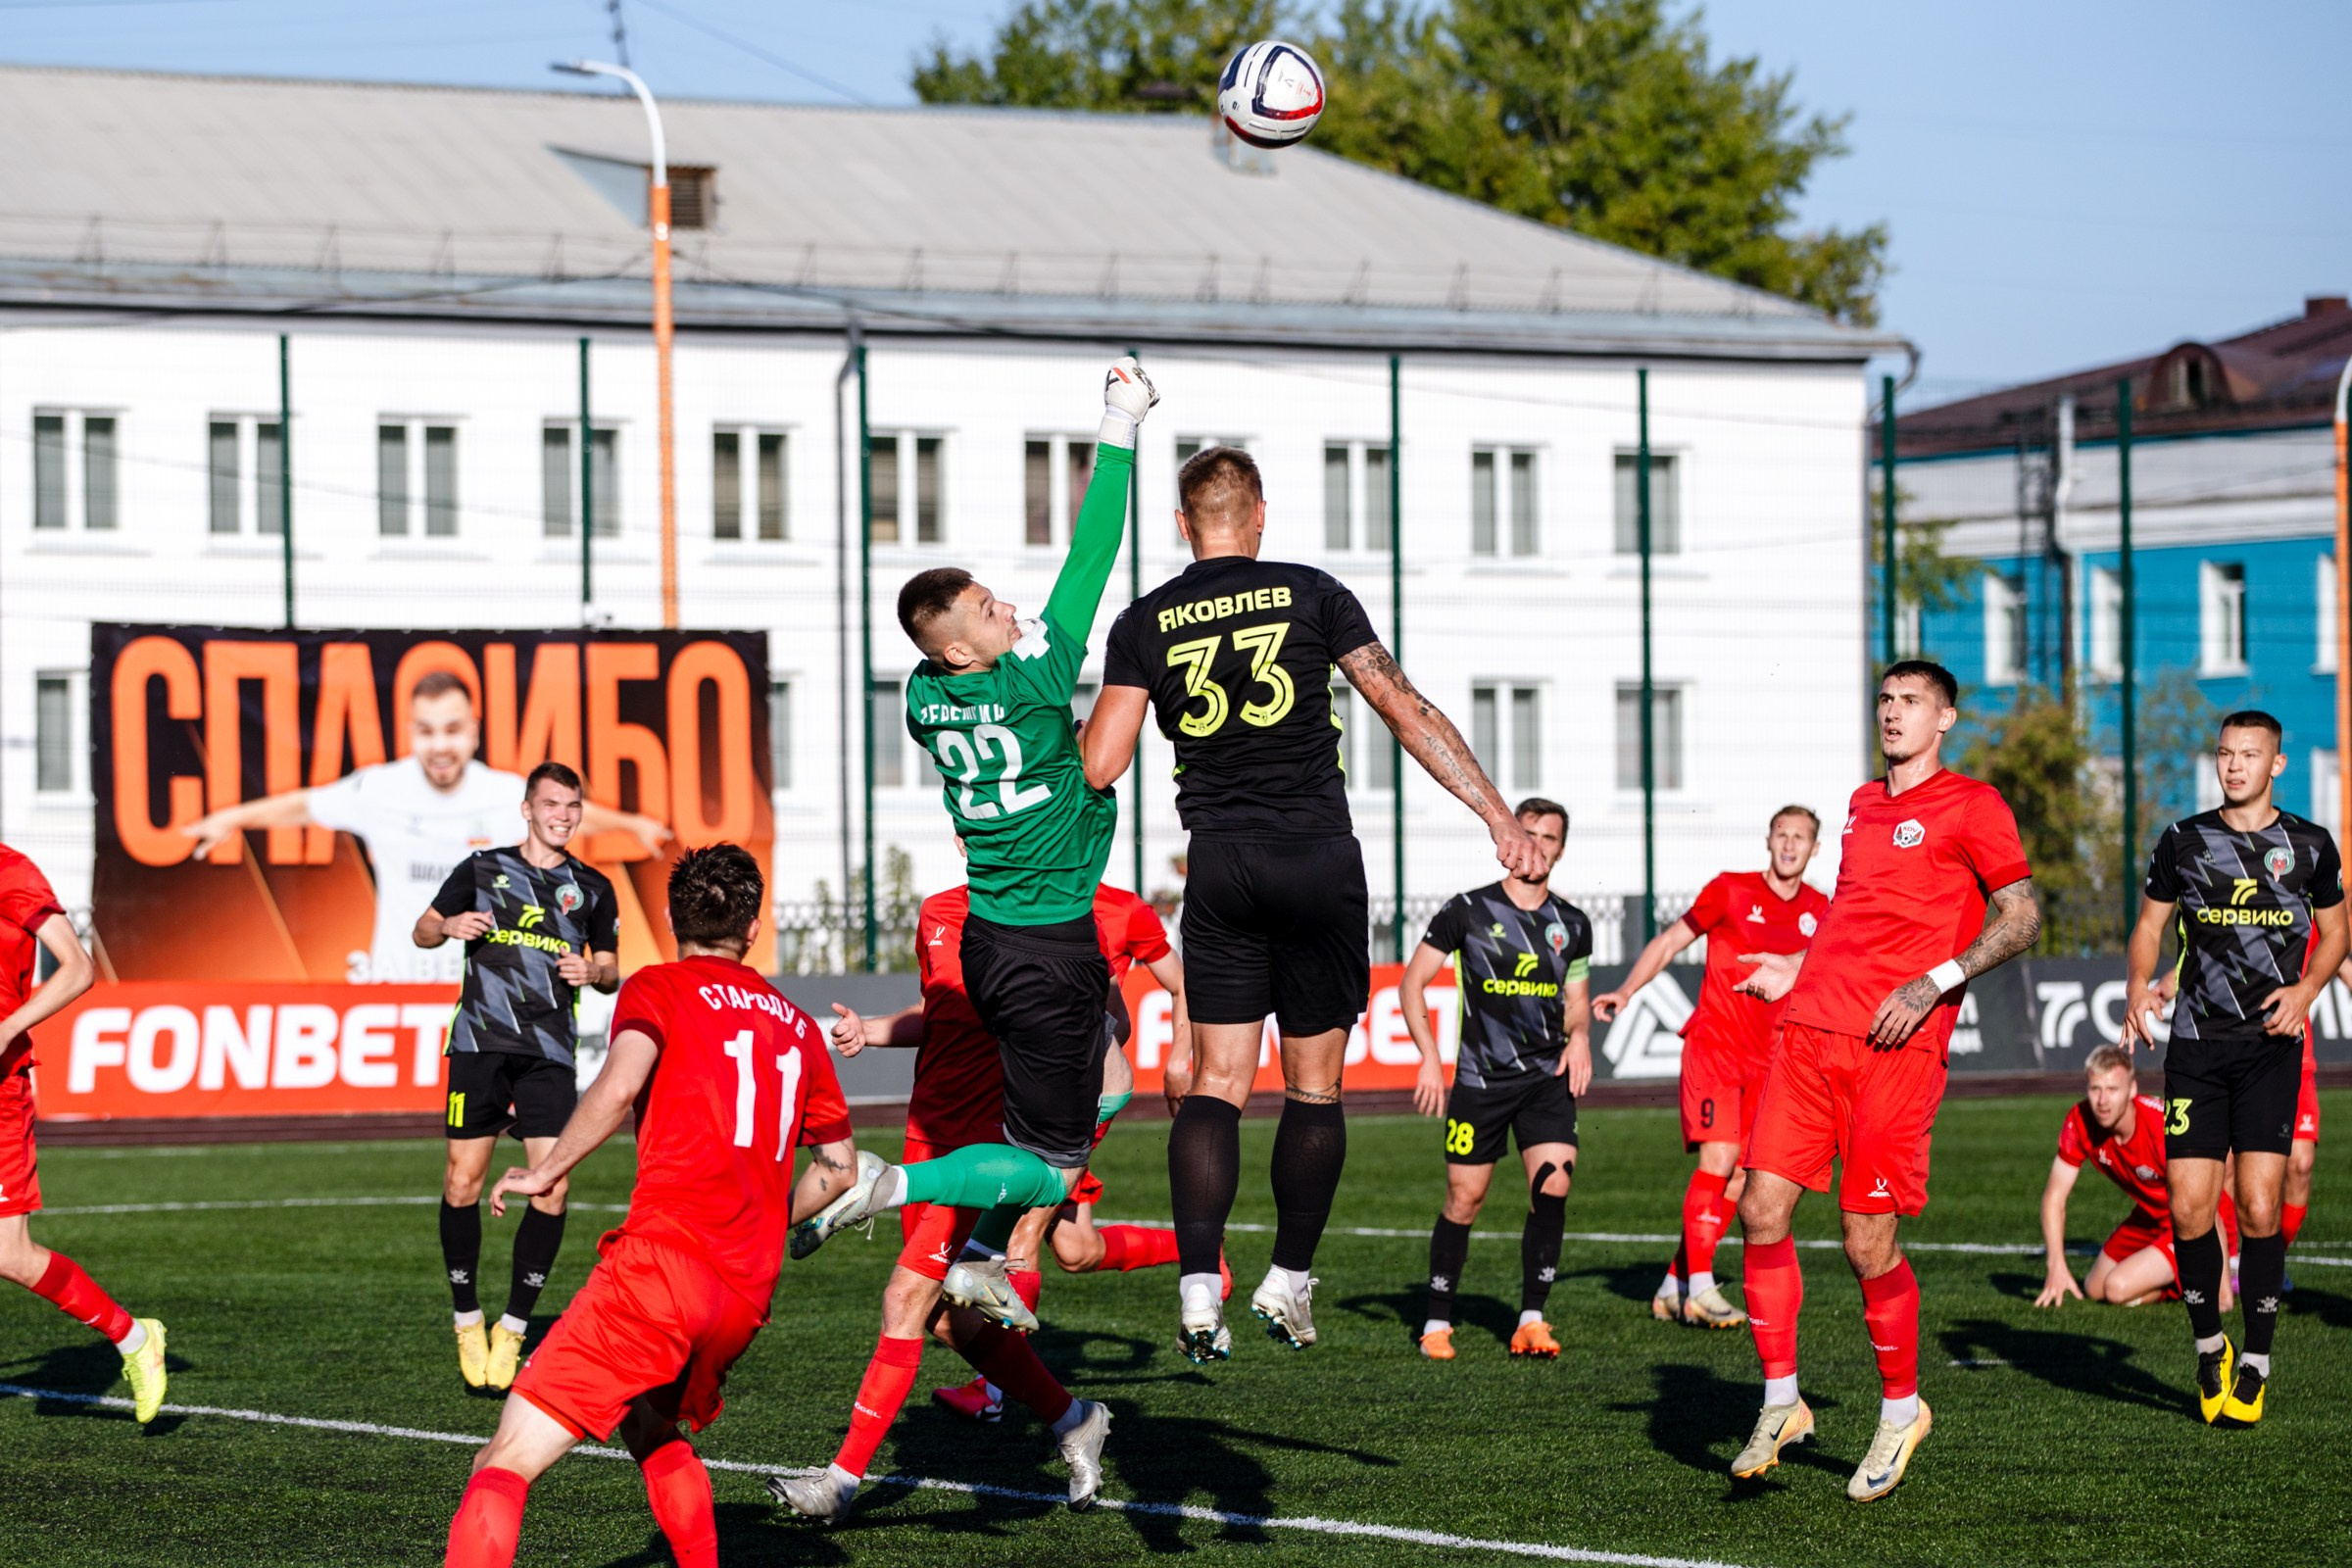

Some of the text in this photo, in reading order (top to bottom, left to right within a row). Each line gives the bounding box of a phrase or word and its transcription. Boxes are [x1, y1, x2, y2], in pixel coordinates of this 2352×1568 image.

[1157, 587, 1292, 633] ЯКОВЛЕВ
[1166, 622, 1295, 737] 33
[936, 723, 1053, 820] 22
[2196, 907, 2294, 927] сервико
[1483, 978, 1558, 998] сервико
[68, 1004, 454, 1095] FONBET
[448, 1091, 466, 1128] 11
[723, 1029, 802, 1162] 11
[1700, 1098, 1714, 1129] 9
[1446, 1118, 1475, 1155] 28
